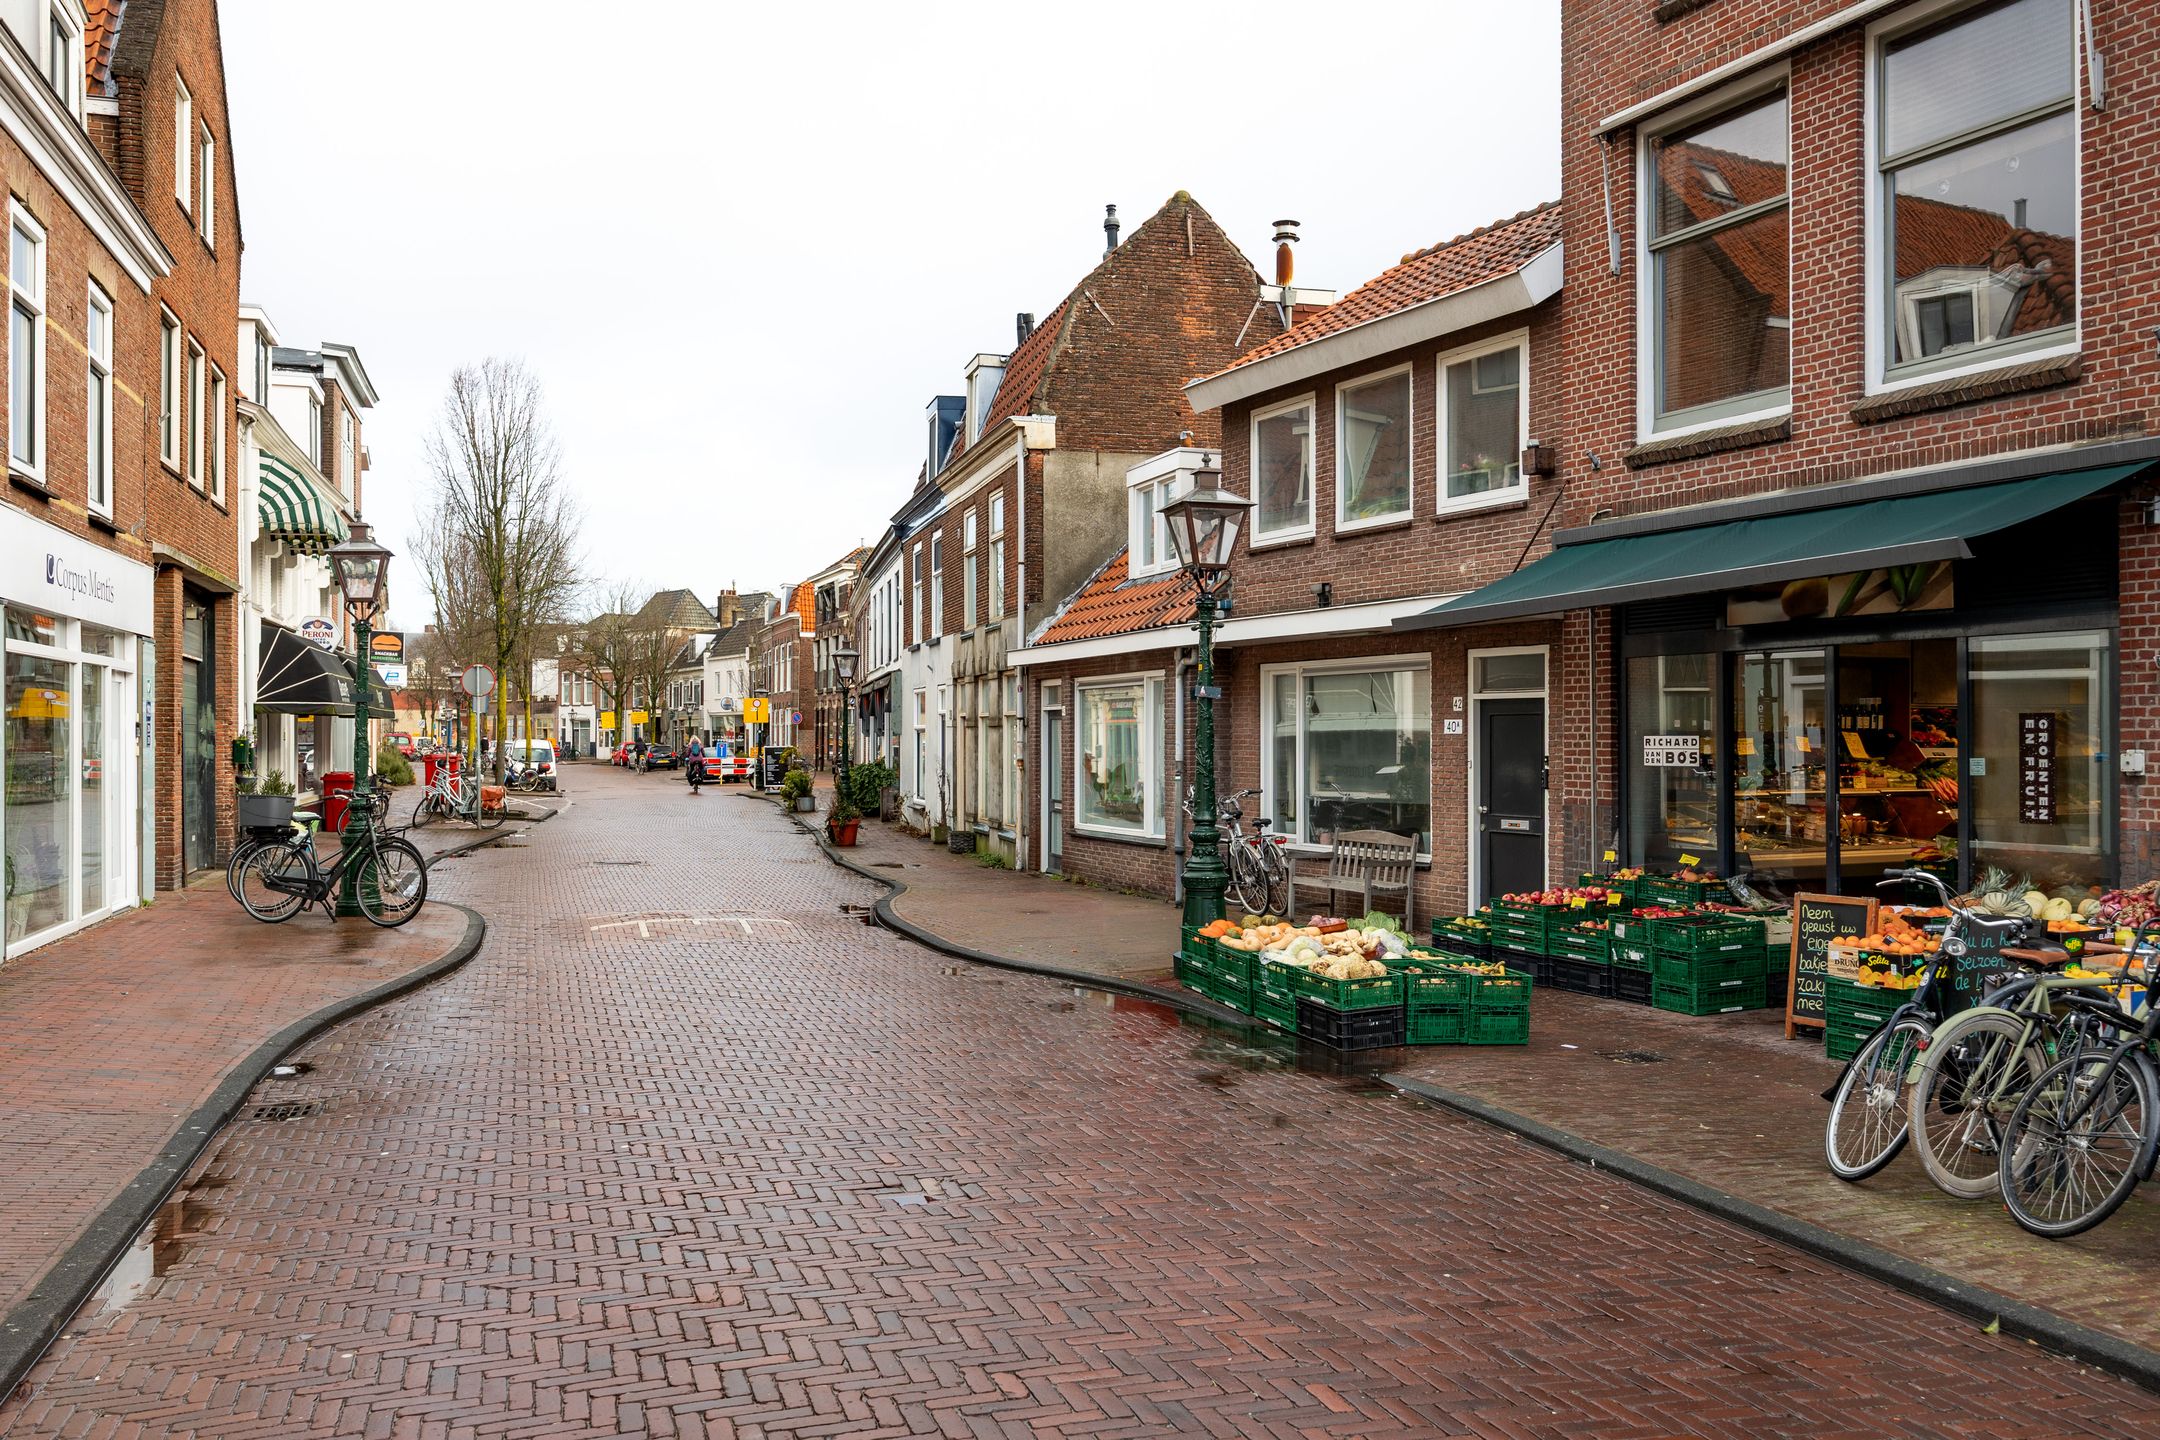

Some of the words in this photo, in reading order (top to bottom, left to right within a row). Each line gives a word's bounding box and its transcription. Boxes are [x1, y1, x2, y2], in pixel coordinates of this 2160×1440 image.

[56, 558, 87, 601] Corpus
[88, 569, 115, 603] Mentis
[302, 630, 333, 638] PERONI
[1454, 699, 1462, 709] 42
[2025, 719, 2035, 744] EN
[1645, 738, 1698, 746] RICHARD
[1665, 752, 1698, 764] BOS
[2038, 719, 2049, 820] GROENTEN
[2025, 757, 2035, 819] FRUIT
[1802, 904, 1834, 919] Neem
[1801, 921, 1836, 939] gerust
[1841, 924, 1856, 933] uw
[1981, 932, 1995, 948] in
[1867, 955, 1890, 966] Solita
[1955, 974, 1970, 991] de
[1797, 998, 1824, 1010] mee
